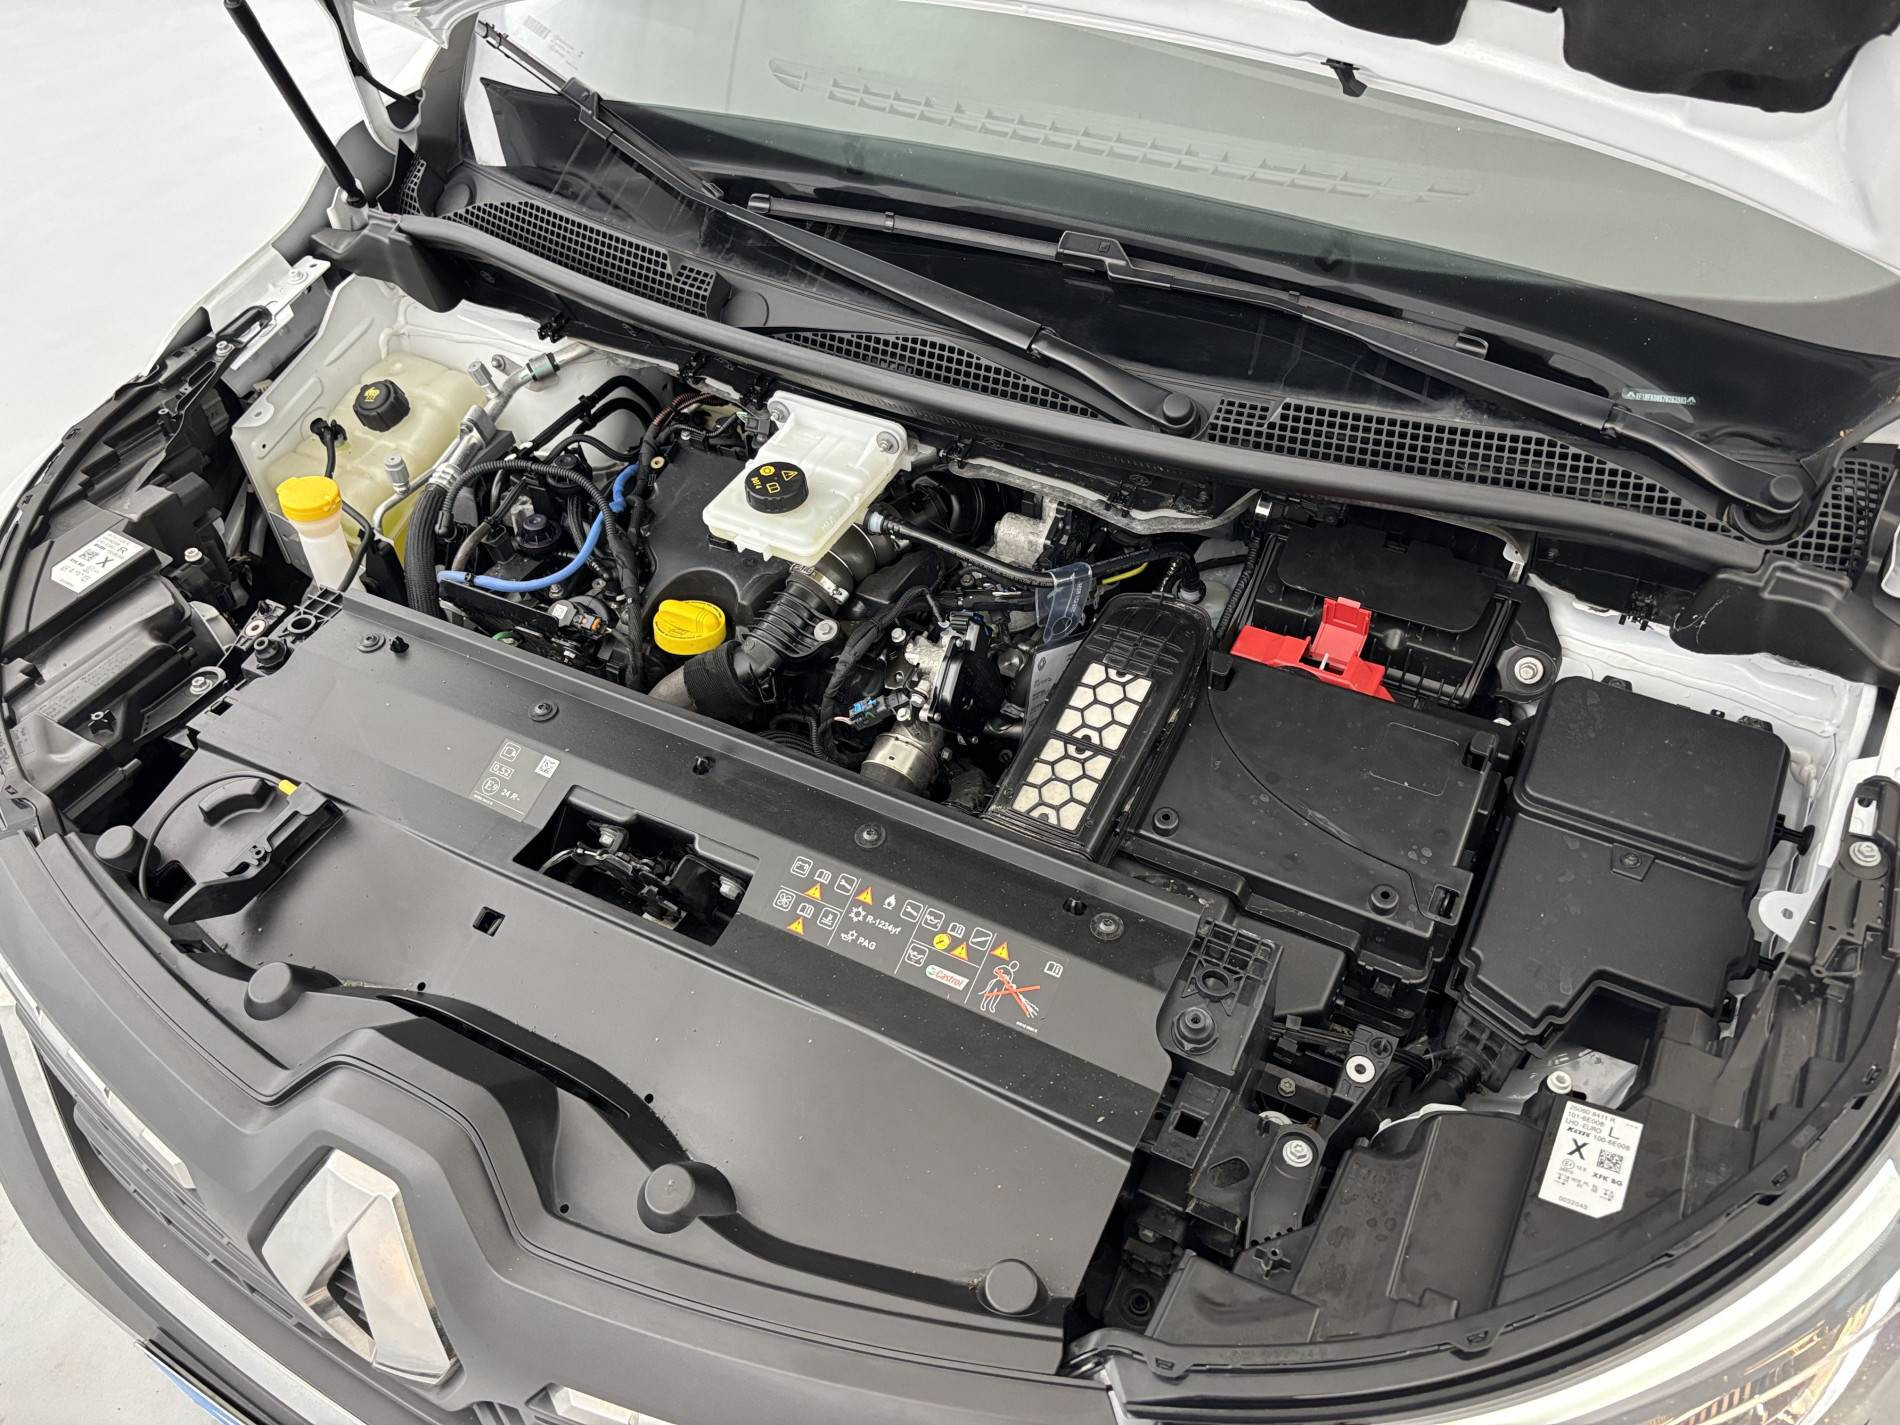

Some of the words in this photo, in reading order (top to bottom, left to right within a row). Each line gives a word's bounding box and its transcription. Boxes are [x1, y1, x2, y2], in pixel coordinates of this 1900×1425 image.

[96, 556, 114, 568] X
[866, 915, 901, 935] R-1234yf
[857, 937, 877, 950] PAG
[935, 970, 964, 987] Castrol
[1608, 1127, 1620, 1139] L
[1567, 1138, 1589, 1160] X
